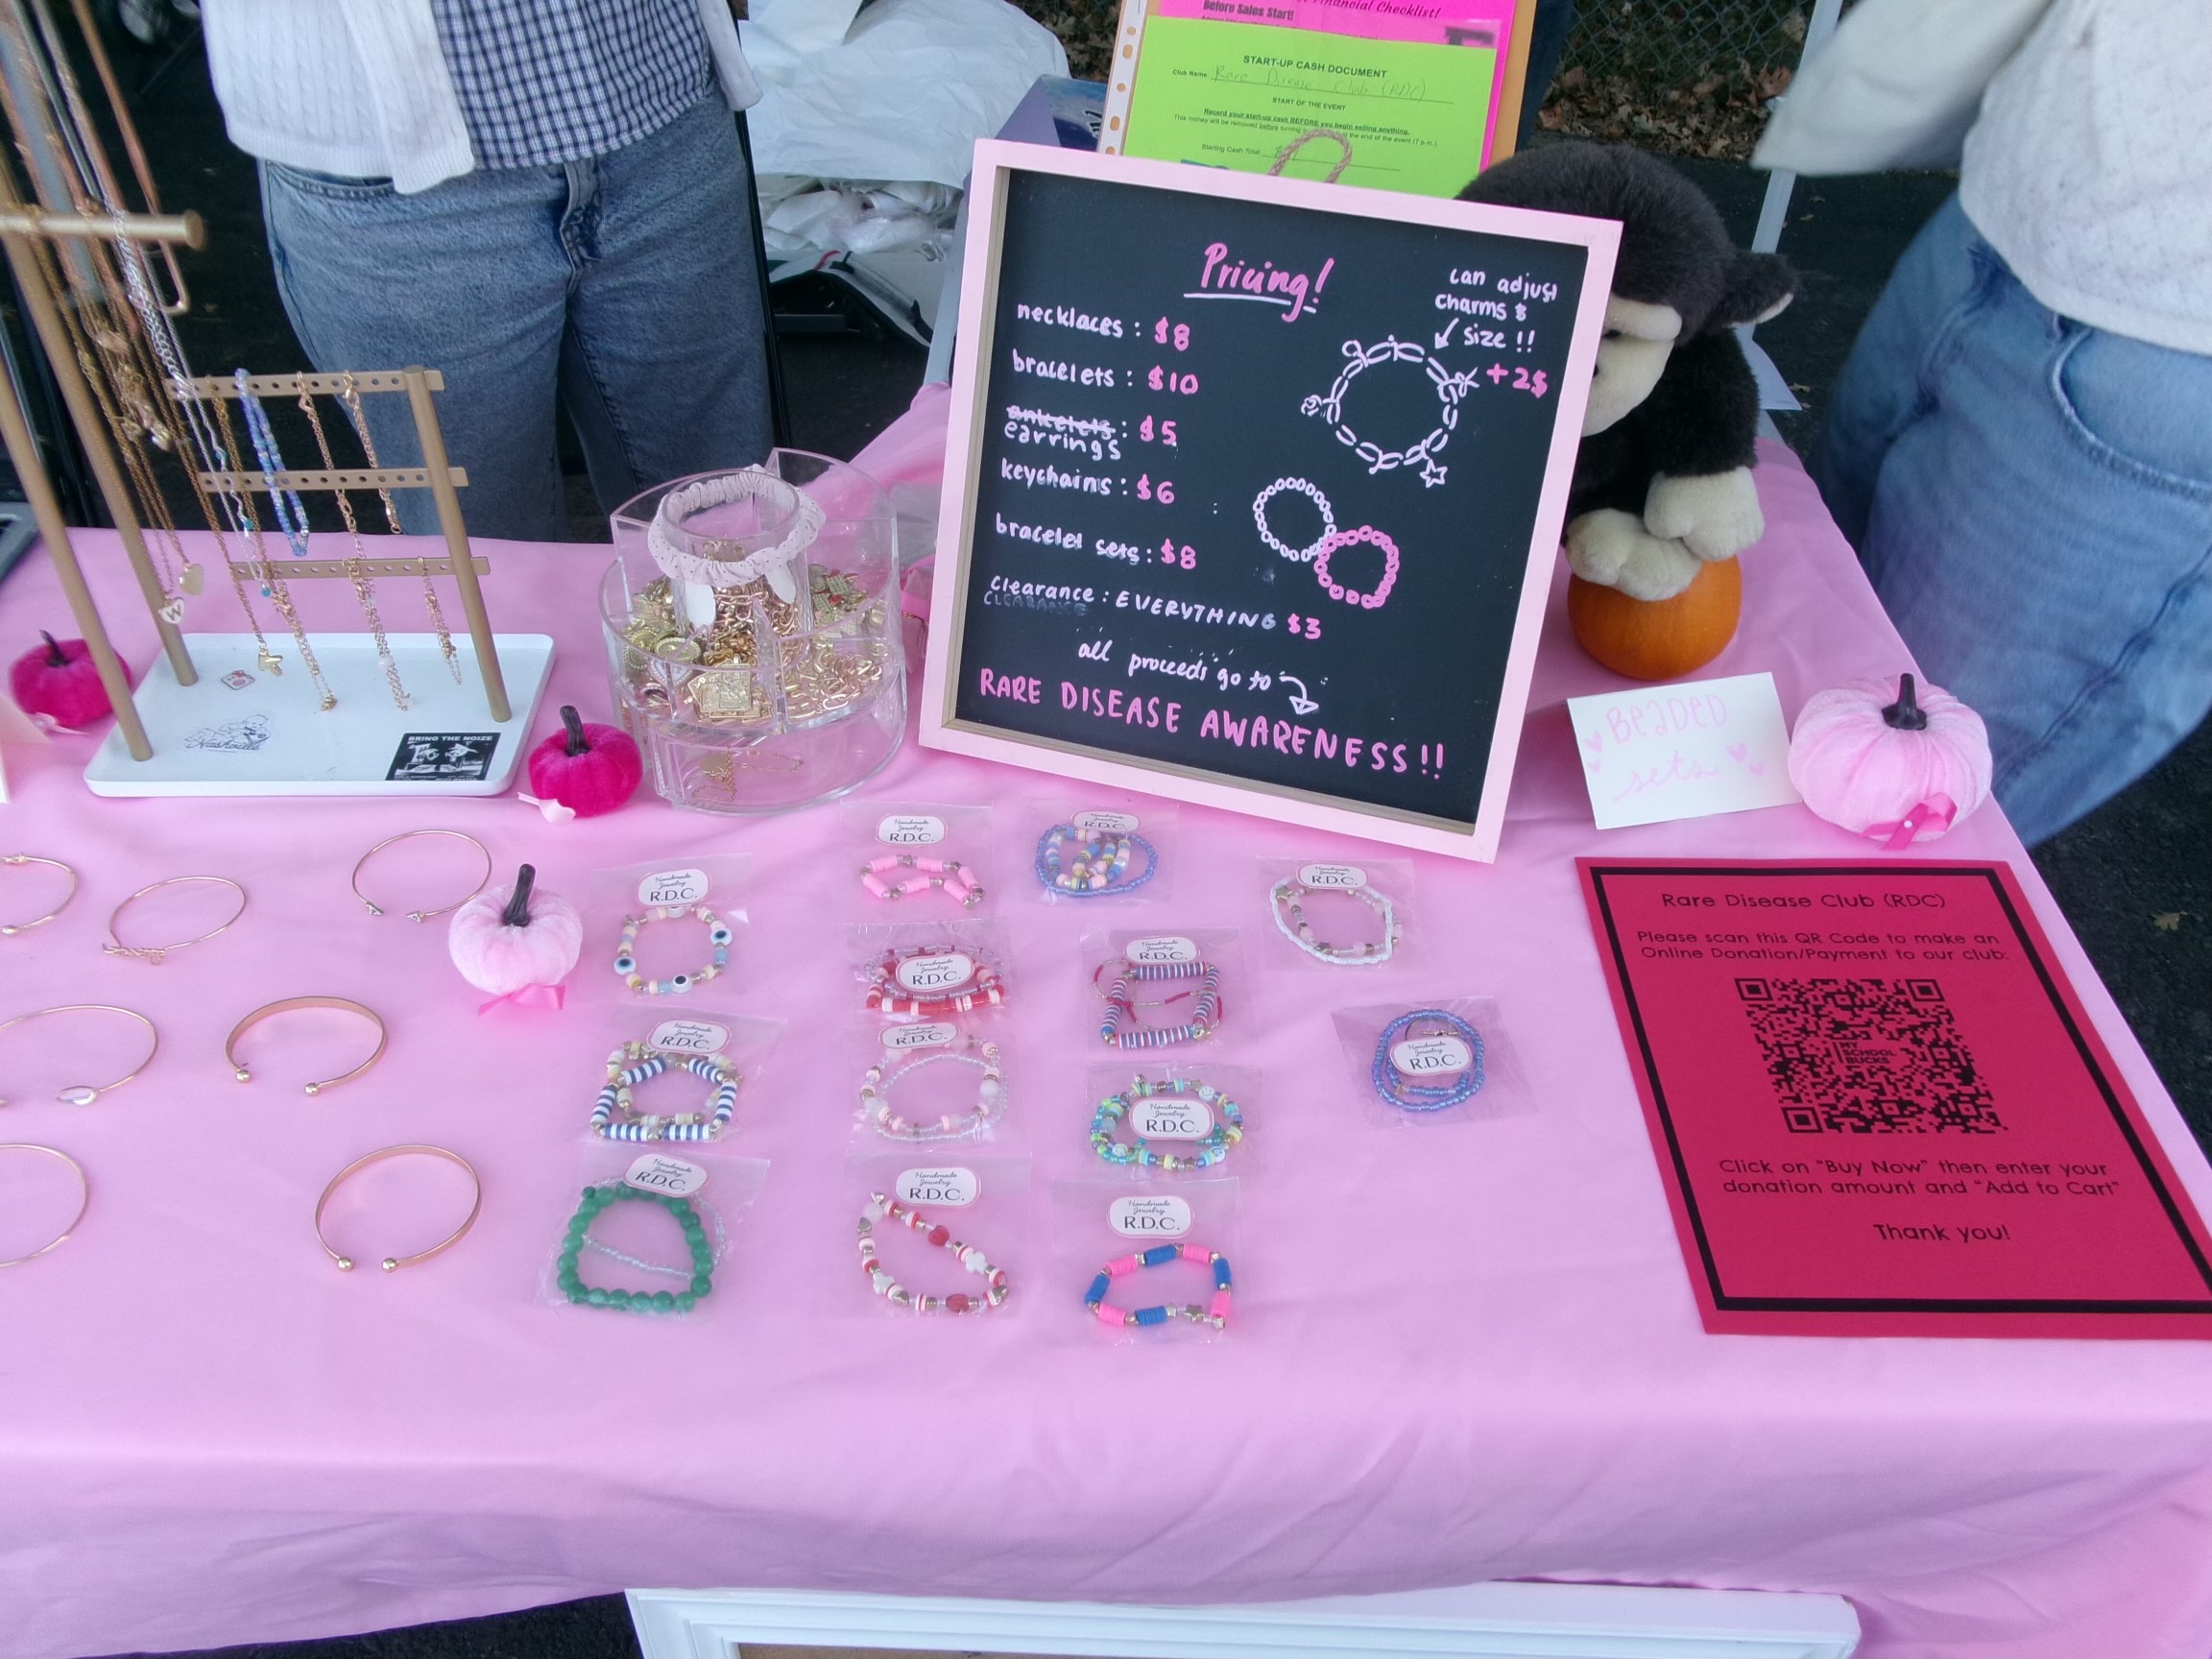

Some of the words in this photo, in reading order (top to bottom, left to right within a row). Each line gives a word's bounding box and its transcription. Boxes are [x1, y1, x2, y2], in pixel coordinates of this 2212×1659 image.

[1203, 0, 1235, 13] Before
[1237, 4, 1264, 16] Sales
[1266, 8, 1294, 20] Start!
[1376, 1, 1442, 19] Checklist!
[1243, 55, 1293, 68] START-UP
[1296, 60, 1325, 72] CASH
[1328, 64, 1387, 79] DOCUMENT
[1323, 103, 1346, 111] EVENT
[1204, 108, 1228, 116] Record
[1229, 110, 1244, 120] your
[1273, 114, 1287, 123] cash
[1289, 116, 1319, 128] BEFORE
[1320, 121, 1333, 130] you
[1334, 121, 1353, 132] begin
[1355, 124, 1377, 133] selling
[1259, 122, 1278, 132] before
[1201, 143, 1225, 153] Starting
[1200, 242, 1335, 323] Pricing!
[1450, 268, 1486, 286] can
[1497, 272, 1558, 302] adjust
[1434, 293, 1507, 321] charms
[1147, 364, 1199, 396] $10
[1004, 421, 1121, 461] earrings
[996, 513, 1083, 550] bracelet
[1115, 589, 1277, 631] EVERYTHING
[1286, 613, 1323, 640] $3
[1077, 638, 1114, 662] all
[1127, 652, 1209, 682] proceeds
[1216, 666, 1241, 691] go
[1248, 669, 1272, 691] to
[979, 666, 1042, 707] RARE
[1060, 680, 1182, 735] DISEASE
[1611, 749, 1720, 805] sets
[1085, 821, 1127, 830] R.D.C.
[890, 833, 934, 842] R.D.C.
[1312, 876, 1358, 885] R.D.C.
[650, 888, 698, 902] R.D.C.
[1661, 893, 1716, 907] Rare
[1726, 893, 1813, 908] Disease
[1820, 893, 1875, 908] Club
[1884, 892, 1946, 909] (RDC)
[1637, 930, 1698, 944] Please
[1705, 933, 1749, 945] scan
[1756, 931, 1789, 945] this
[1794, 931, 1823, 945] QR
[1829, 932, 1880, 945] Code
[1887, 933, 1907, 945] to
[1913, 932, 1966, 946] make
[1973, 935, 2000, 946] an
[1140, 951, 1188, 960] R.D.C.
[1641, 946, 1704, 960] Online
[1711, 947, 1888, 963] Donation/Payment
[1895, 949, 1913, 960] to
[1922, 950, 1955, 961] our
[912, 971, 961, 985] R.D.C.
[661, 1036, 709, 1049] R.D.C.
[897, 1033, 947, 1045] R.D.C.
[1841, 1048, 1897, 1057] SCHOOL
[1409, 1054, 1461, 1070] R.D.C.
[1146, 1119, 1199, 1133] R.D.C.
[1719, 1159, 1774, 1174] Click
[1781, 1163, 1810, 1174] on
[1815, 1159, 1863, 1177] "Buy
[1871, 1159, 1929, 1175] Now"
[1937, 1160, 1988, 1175] then
[1995, 1162, 2052, 1176] enter
[2059, 1164, 2107, 1179] your
[636, 1171, 685, 1190] R.D.C.
[1722, 1178, 1823, 1195] donation
[1830, 1180, 1917, 1195] amount
[1925, 1179, 1968, 1195] and
[1974, 1179, 2030, 1196] "Add
[2038, 1182, 2059, 1196] to
[2066, 1181, 2121, 1197] Cart"
[910, 1188, 964, 1201] R.D.C.
[1124, 1216, 1179, 1230] R.D.C.
[1872, 1223, 1952, 1241] Thank
[1957, 1224, 2012, 1244] you!
